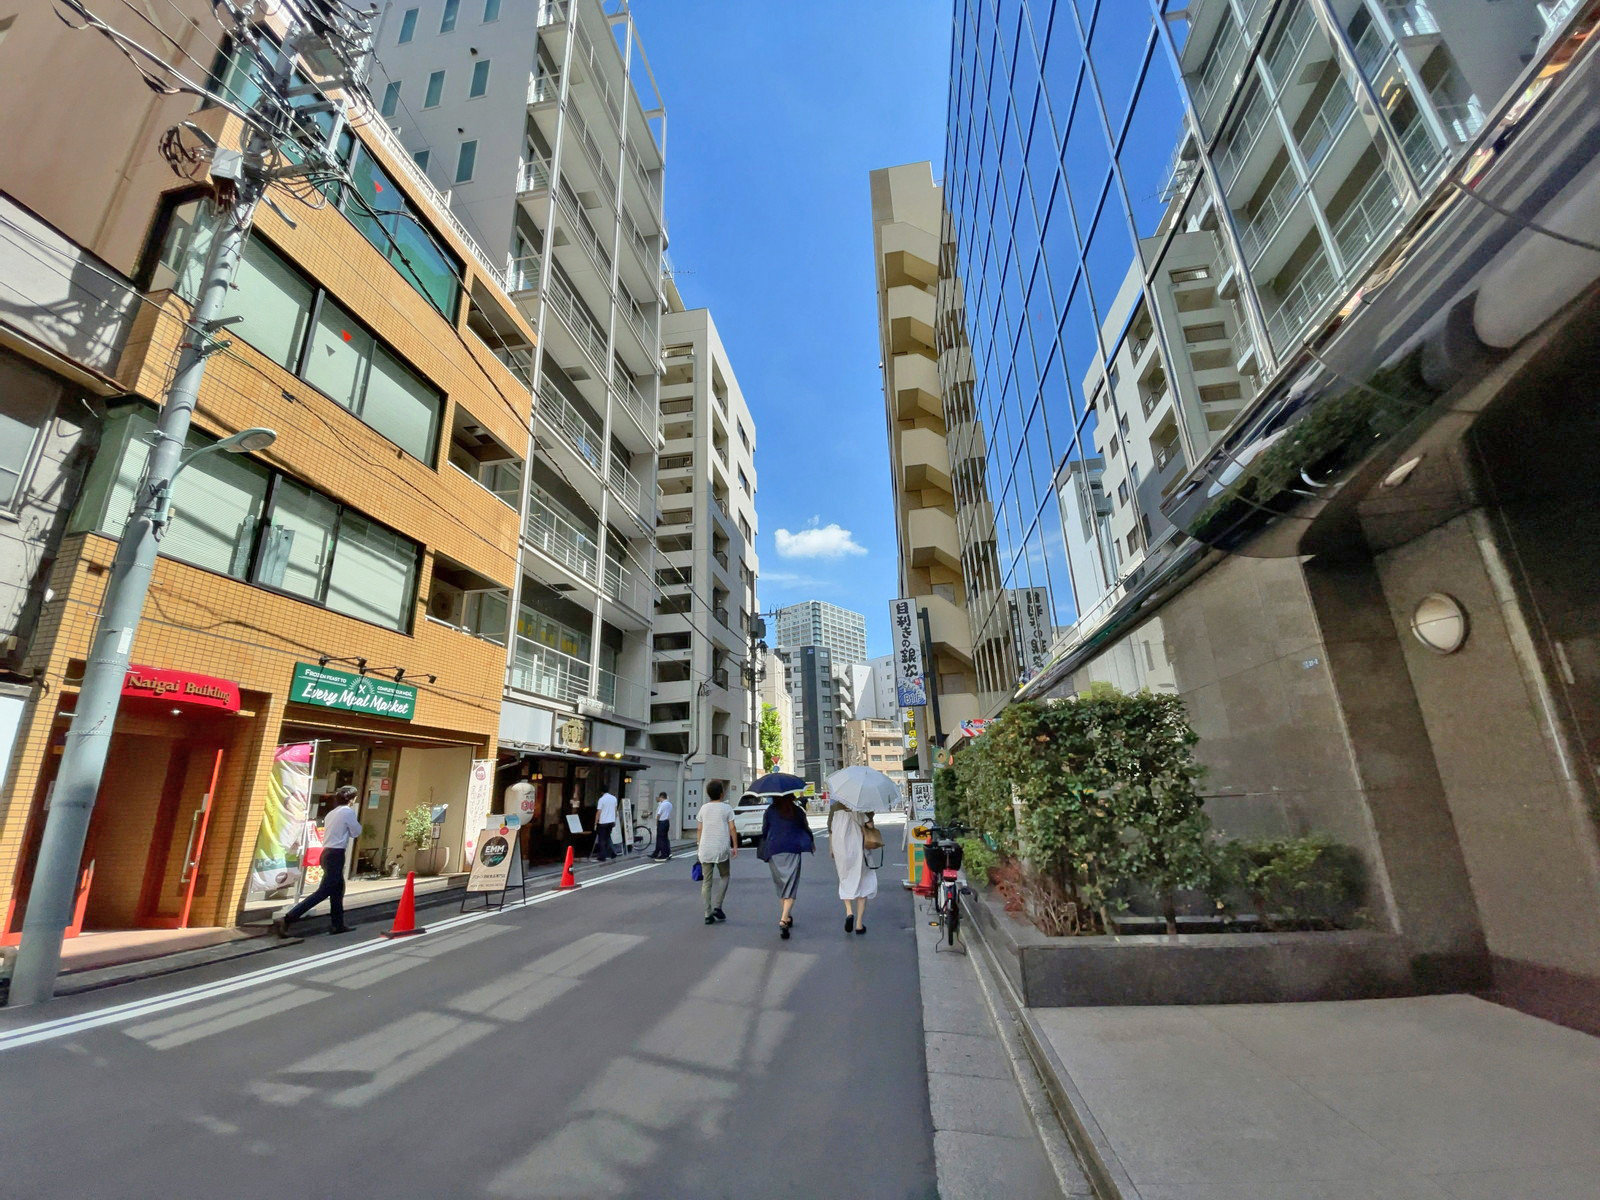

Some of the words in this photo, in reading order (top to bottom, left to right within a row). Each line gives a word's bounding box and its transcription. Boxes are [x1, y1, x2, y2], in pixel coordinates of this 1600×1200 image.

[895, 601, 918, 678] 目利きの銀次
[128, 675, 180, 694] Naigai
[185, 682, 231, 704] Building
[301, 682, 338, 706] Every
[339, 689, 370, 708] Meal
[369, 695, 409, 714] Market
[904, 691, 920, 704] B1F
[485, 845, 505, 853] EMM
